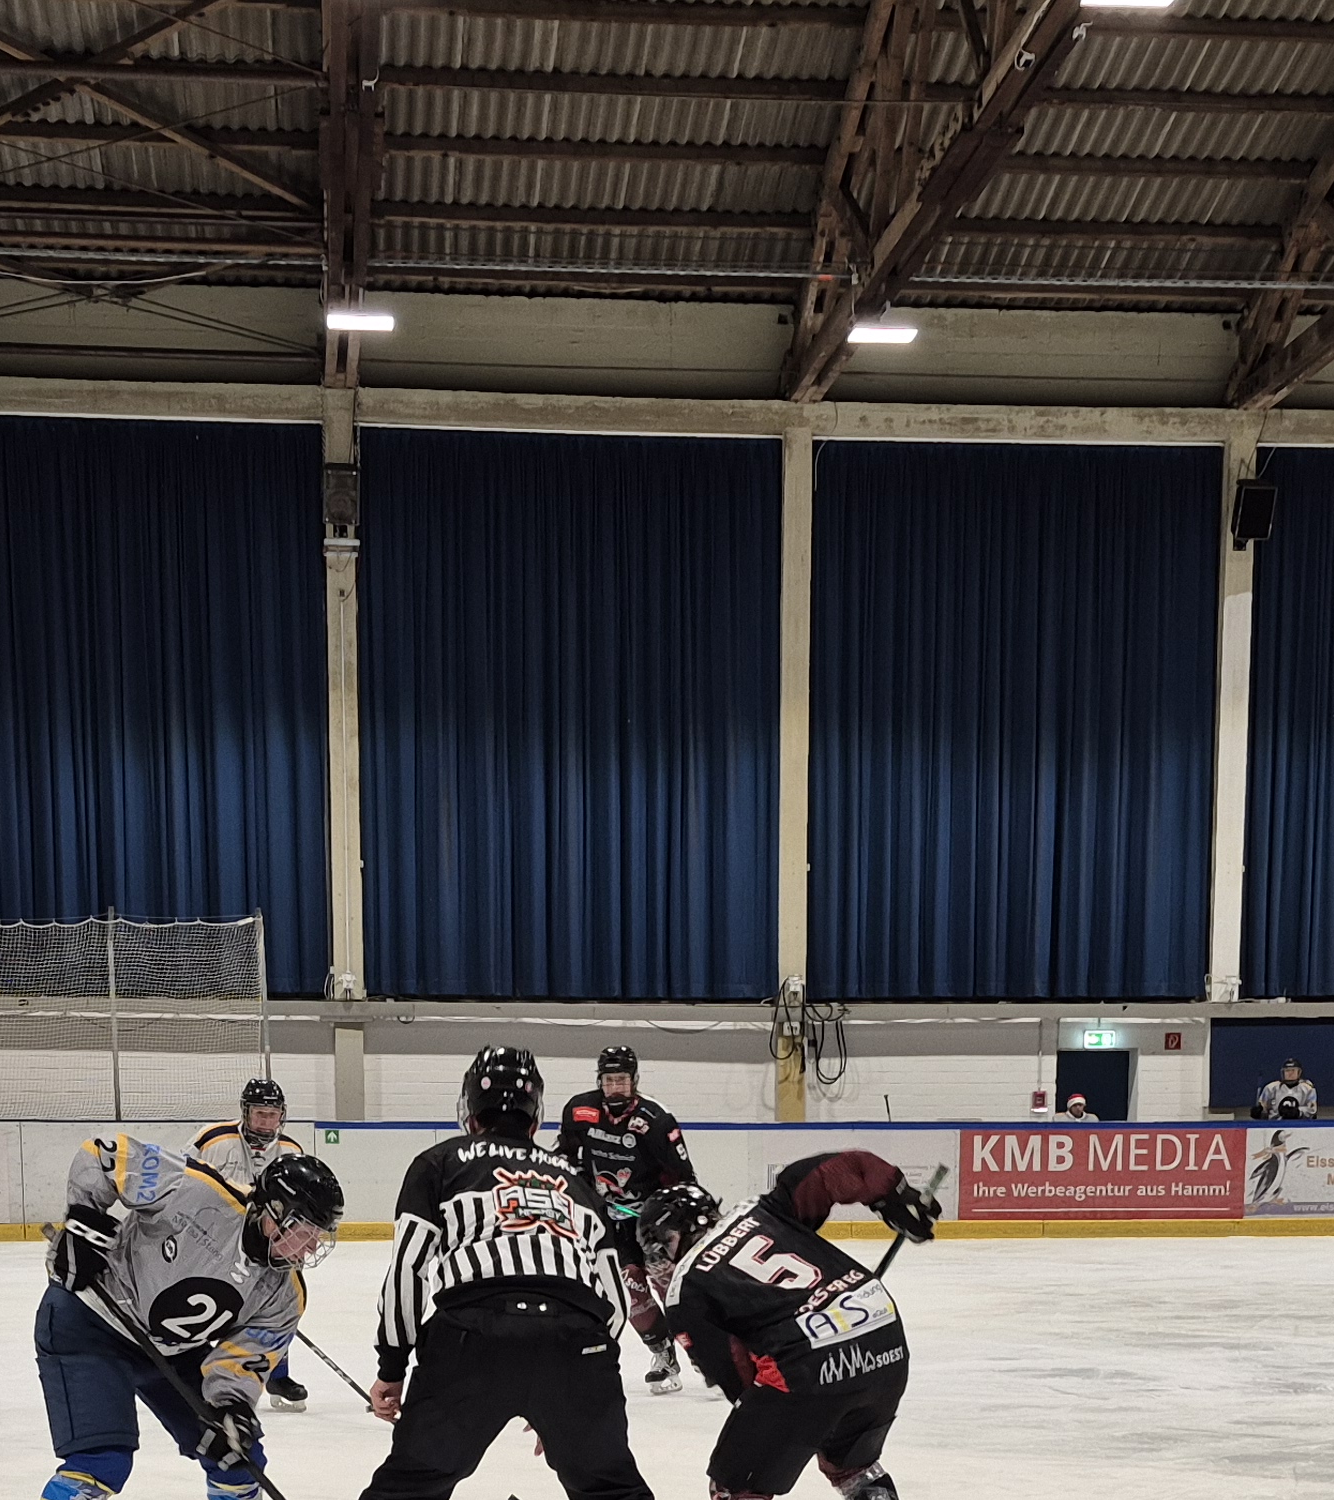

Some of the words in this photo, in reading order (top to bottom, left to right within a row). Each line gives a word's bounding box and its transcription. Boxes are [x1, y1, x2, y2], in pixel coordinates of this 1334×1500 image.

[457, 1141, 487, 1163] WE
[488, 1143, 527, 1161] LIVE
[972, 1134, 1074, 1172] KMB
[1088, 1134, 1232, 1172] MEDIA
[973, 1182, 1006, 1197] Ihre
[1011, 1182, 1133, 1201] Werbeagentur
[1136, 1184, 1166, 1196] aus
[1171, 1181, 1231, 1196] Hamm!
[695, 1217, 761, 1273] LÜBBERT
[728, 1234, 824, 1291] 5
[161, 1293, 233, 1341] 21
[876, 1346, 904, 1369] SOEST
